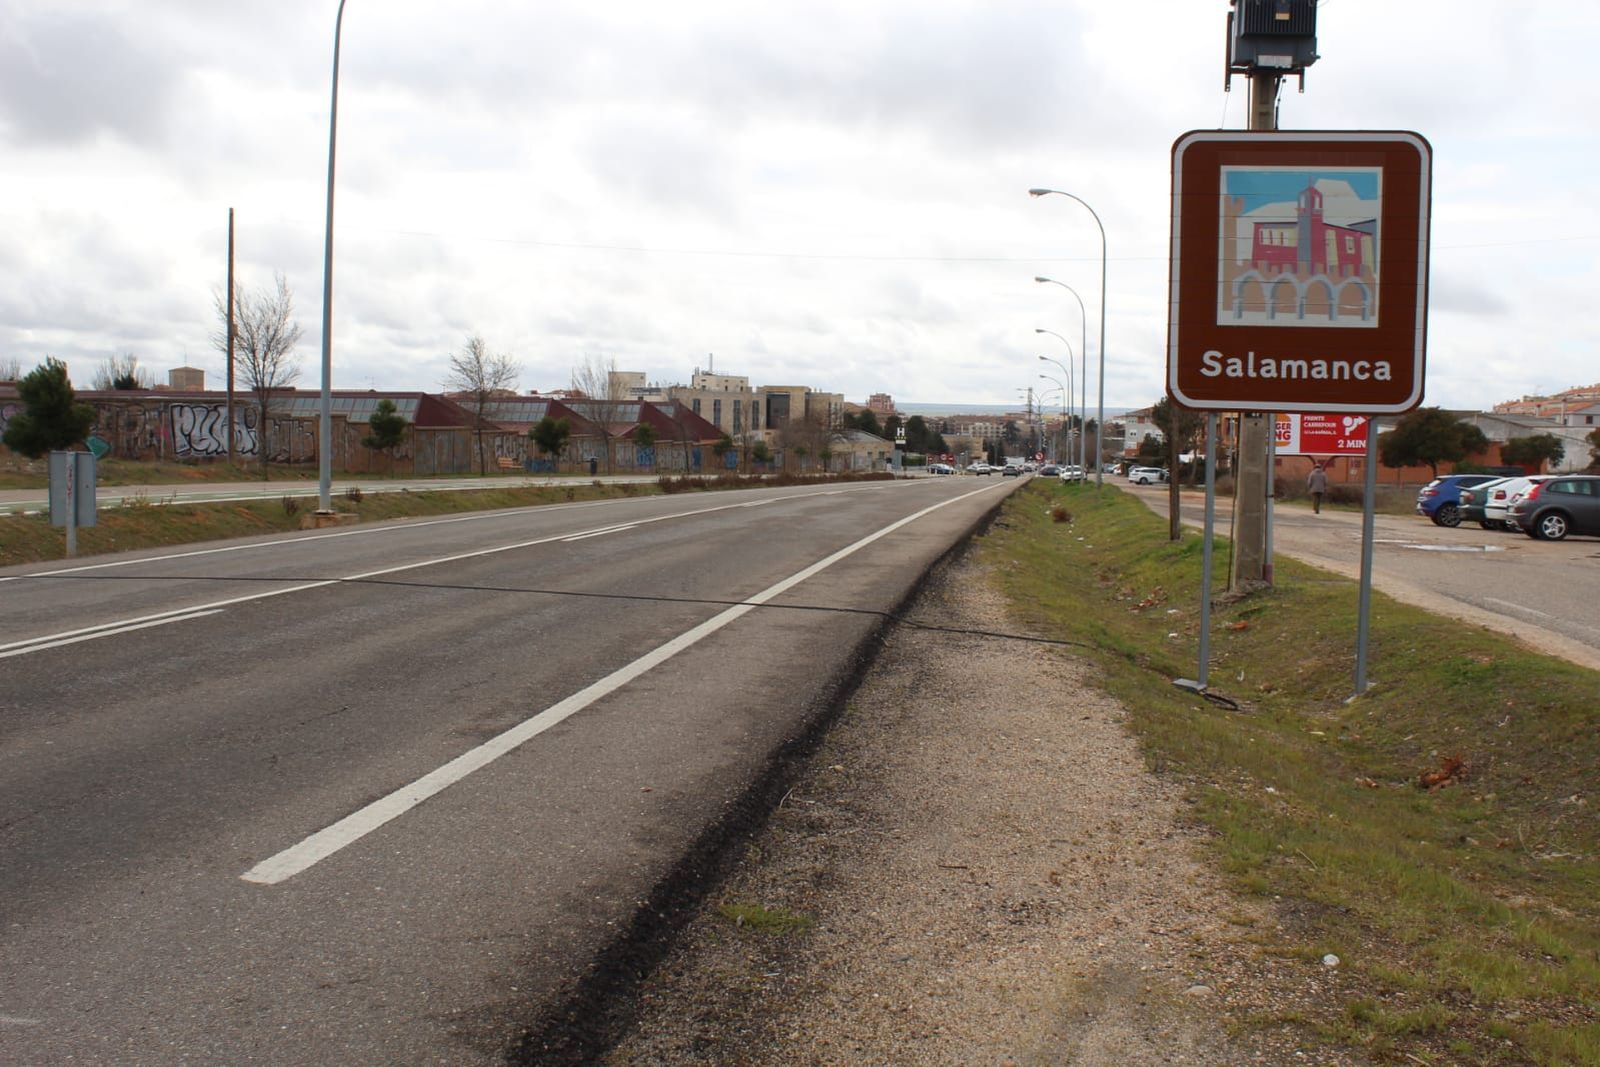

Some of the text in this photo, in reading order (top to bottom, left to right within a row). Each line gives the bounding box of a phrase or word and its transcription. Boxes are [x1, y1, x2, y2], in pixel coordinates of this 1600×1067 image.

[1200, 350, 1392, 380] Salamanca
[897, 427, 905, 436] H
[1275, 431, 1292, 441] NG
[1337, 440, 1367, 448] 2 MIN
